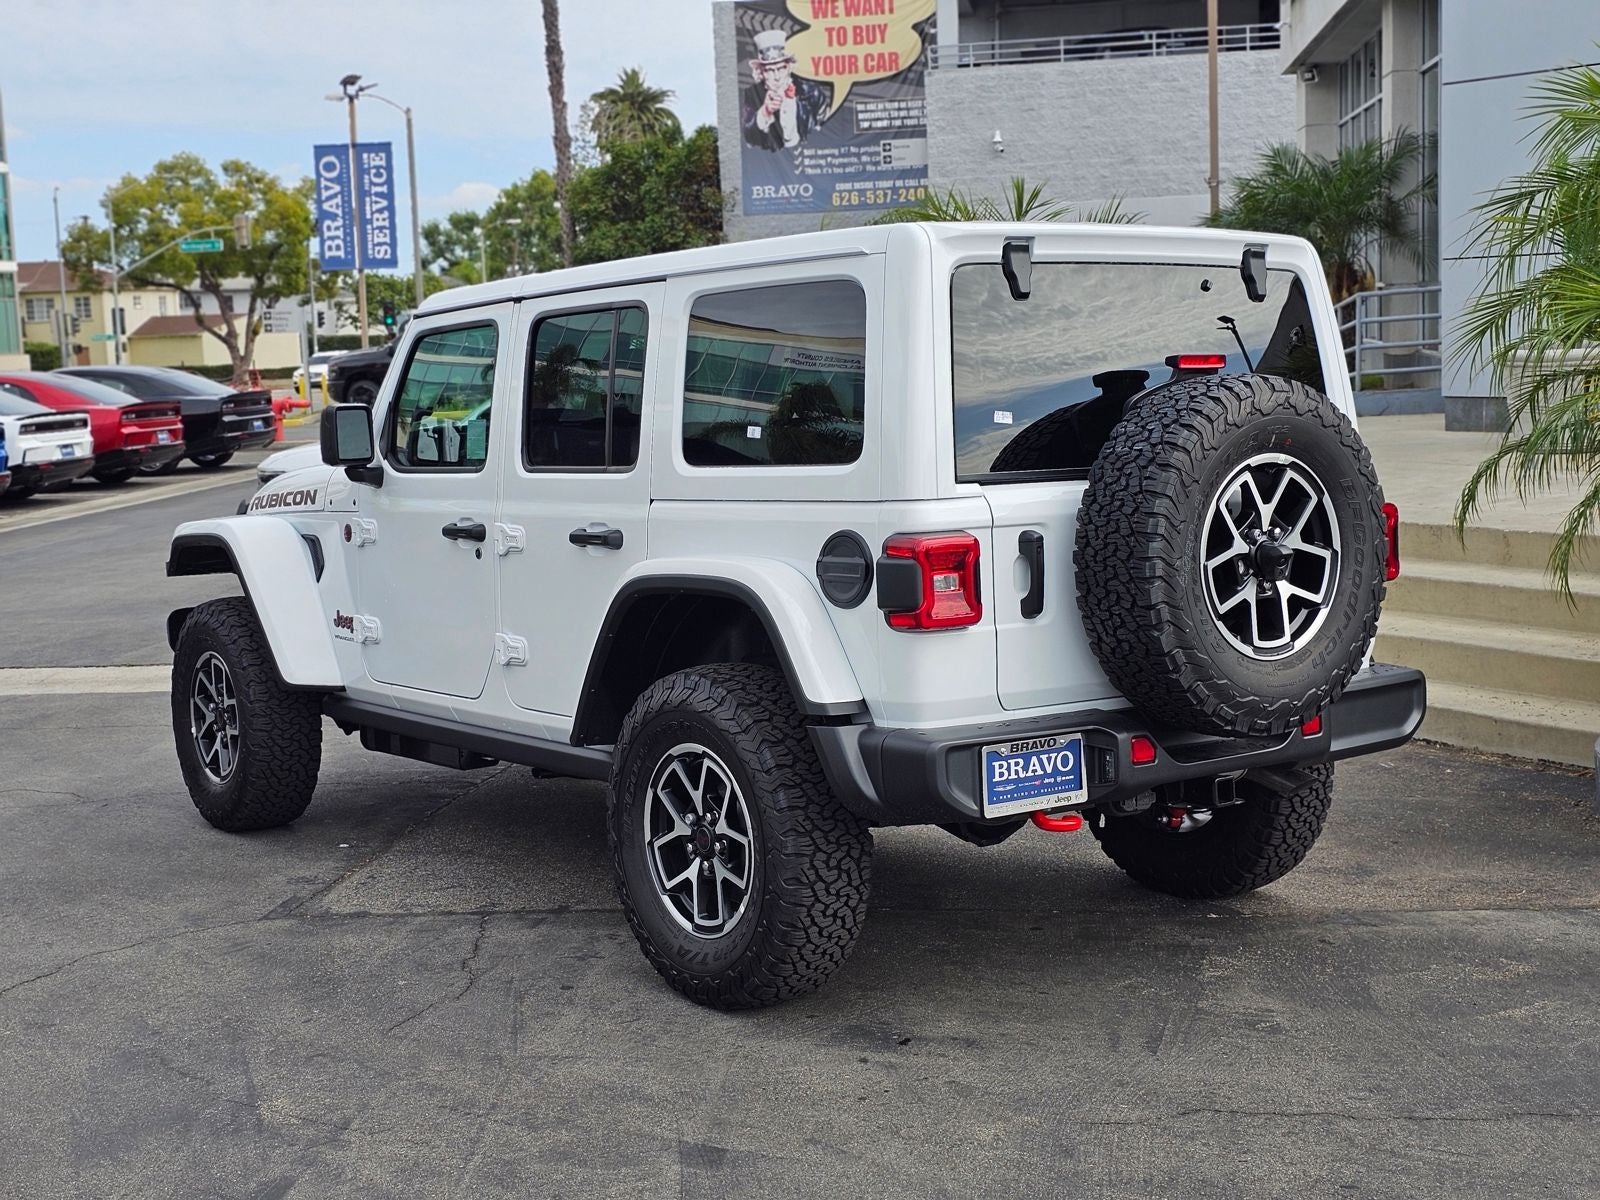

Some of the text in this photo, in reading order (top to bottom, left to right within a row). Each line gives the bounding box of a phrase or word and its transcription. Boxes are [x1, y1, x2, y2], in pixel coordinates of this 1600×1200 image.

[811, 0, 895, 19] WE WANT
[824, 23, 888, 48] TO BUY
[811, 51, 900, 77] YOUR CAR
[751, 183, 814, 199] BRAVO
[318, 155, 345, 259] BRAVO
[370, 152, 392, 259] SERVICE
[251, 489, 318, 511] RUBICON
[1009, 738, 1057, 753] BRAVO
[992, 751, 1074, 782] BRAVO
[1054, 795, 1072, 804] Jeep
